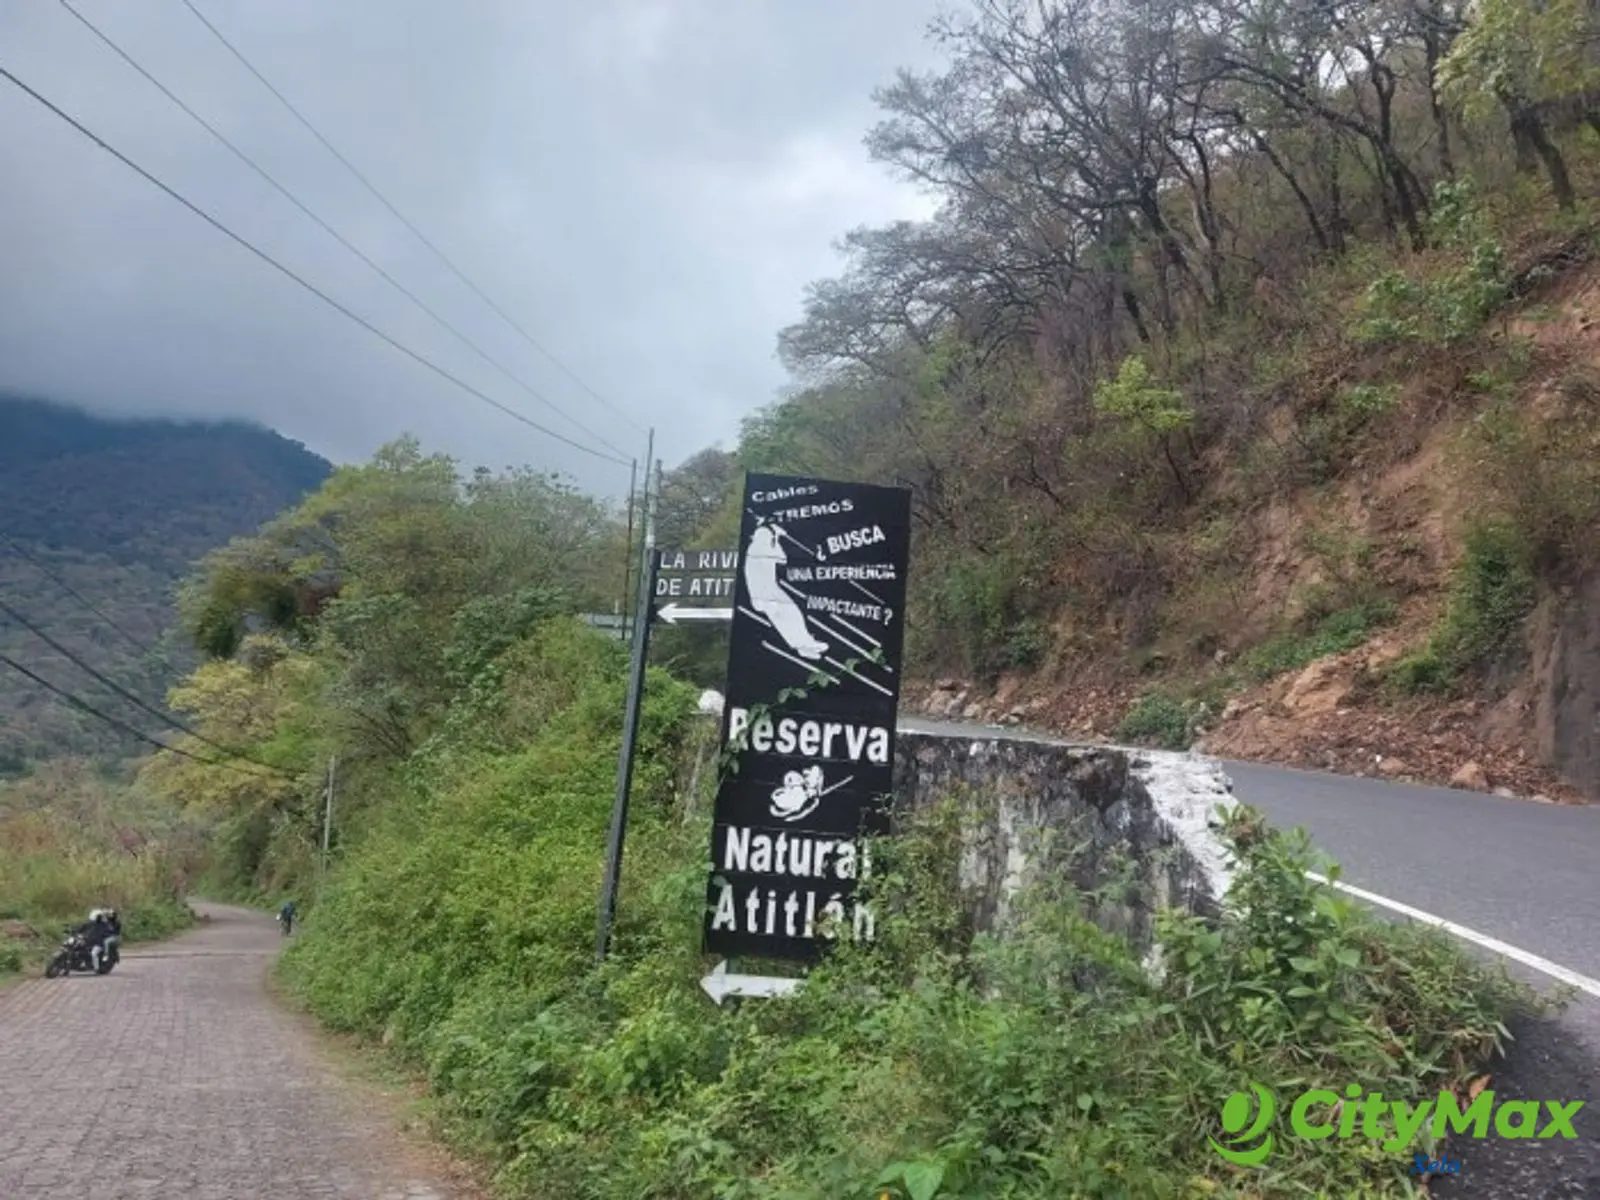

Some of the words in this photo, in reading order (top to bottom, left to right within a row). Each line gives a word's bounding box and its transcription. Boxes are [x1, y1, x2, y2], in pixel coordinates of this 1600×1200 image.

[660, 551, 685, 569] LA
[786, 567, 813, 582] UNA
[656, 578, 682, 596] DE
[729, 707, 889, 763] Reserva
[724, 826, 873, 880] Natural
